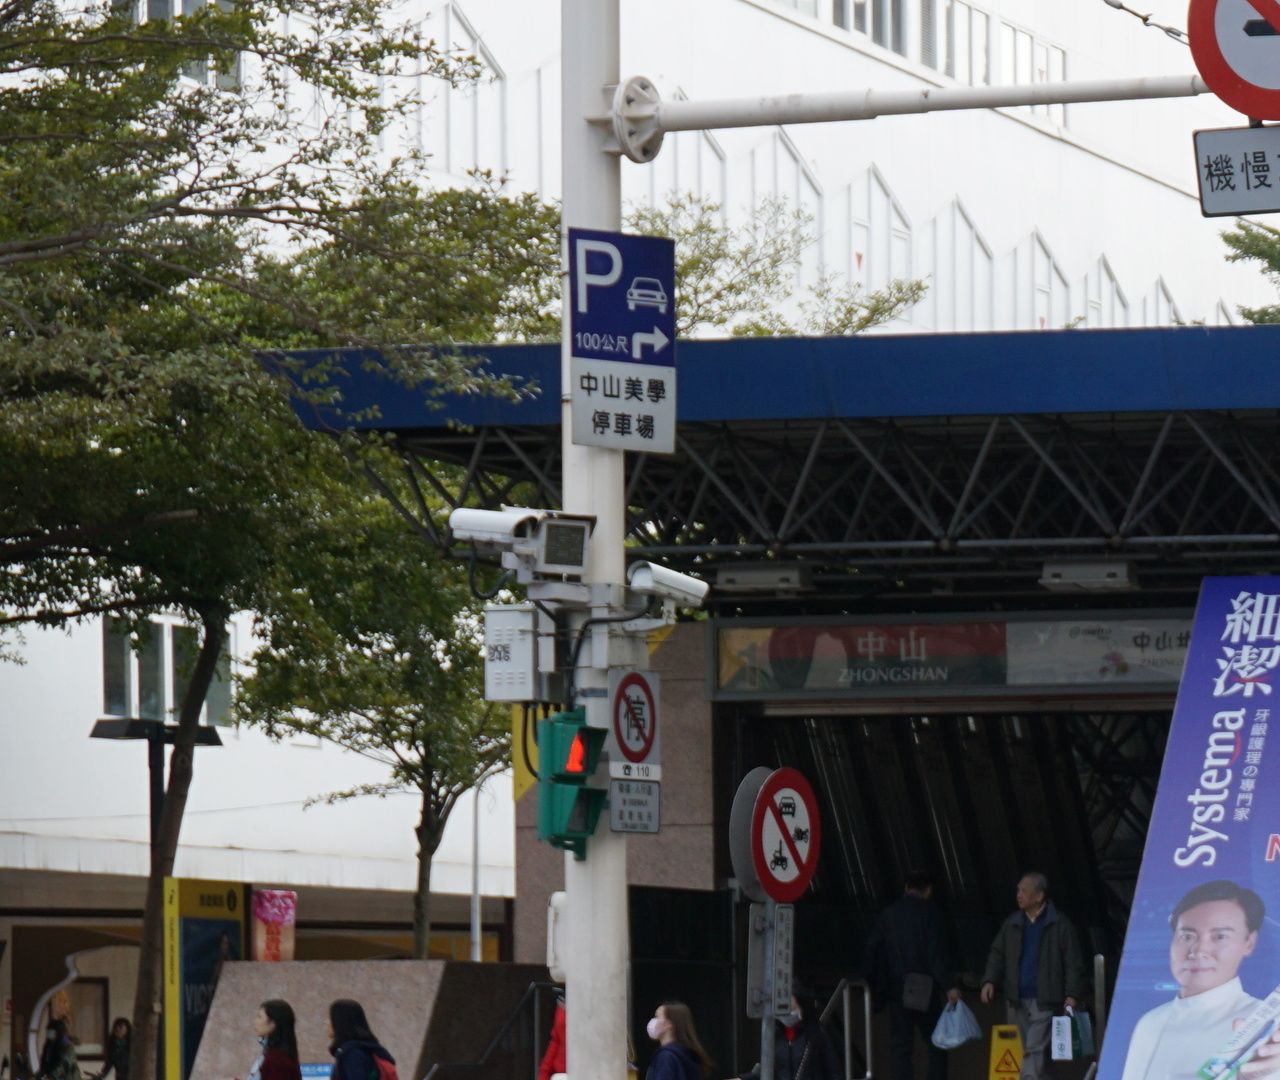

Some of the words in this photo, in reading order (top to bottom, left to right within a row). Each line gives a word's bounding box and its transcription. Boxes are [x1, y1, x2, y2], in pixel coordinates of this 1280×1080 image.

[575, 238, 623, 314] P
[575, 331, 630, 354] 100公尺
[580, 371, 667, 404] 中山美學
[591, 408, 656, 440] 停車場
[856, 630, 927, 664] 中山
[837, 666, 949, 684] ZHONGSHAN
[1173, 707, 1246, 868] Systema
